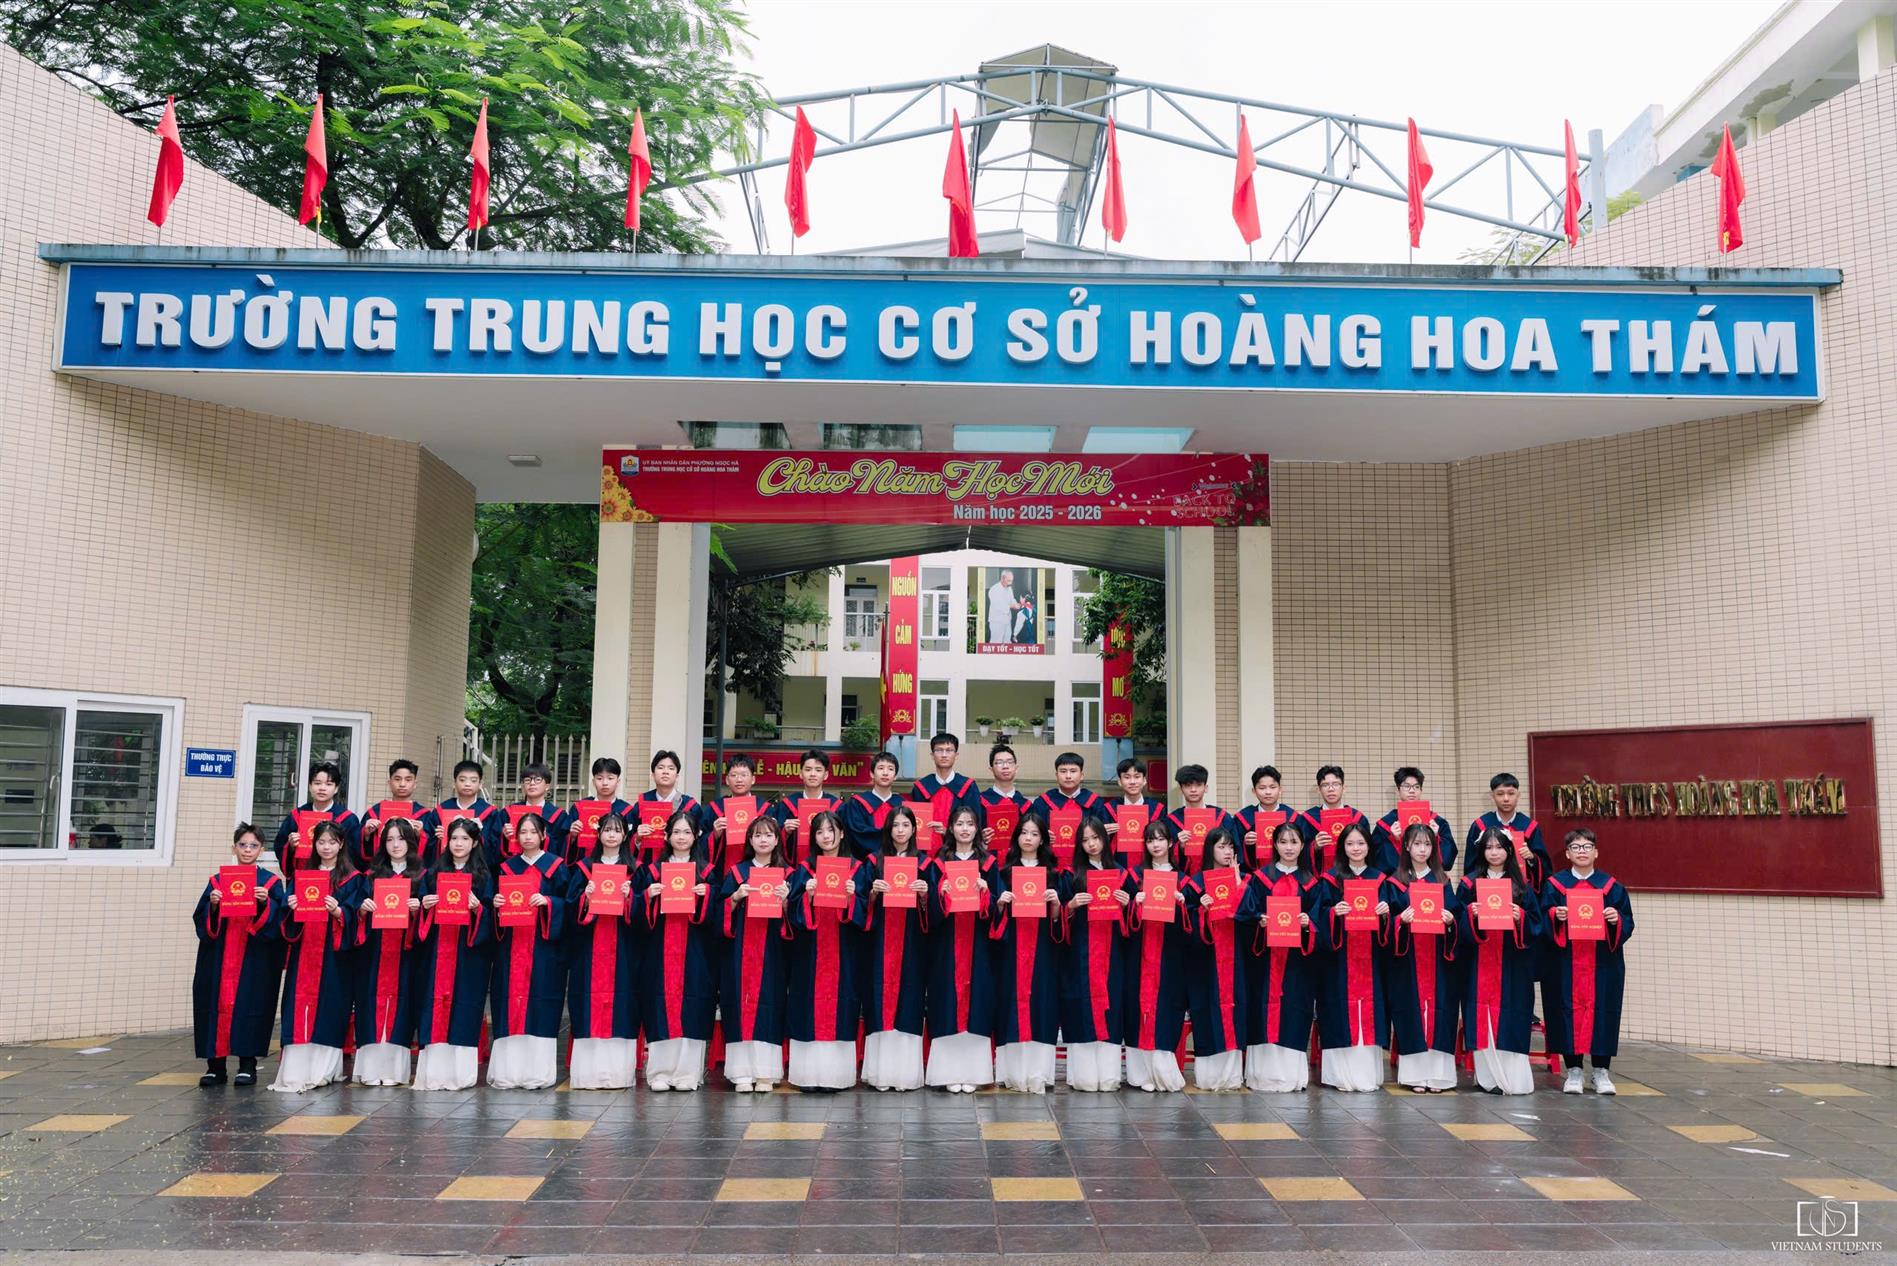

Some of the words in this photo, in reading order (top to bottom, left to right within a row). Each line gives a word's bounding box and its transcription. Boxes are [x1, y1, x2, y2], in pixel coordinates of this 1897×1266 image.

[95, 274, 398, 352] TRƯỜNG
[425, 298, 671, 356] TRUNG
[699, 302, 848, 373] HỌC
[878, 301, 977, 361] CƠ
[1005, 286, 1102, 365] SỞ
[1129, 293, 1382, 370] HOÀNG
[1410, 315, 1560, 373] HOA
[1580, 304, 1799, 376] THÁM
[757, 457, 855, 496] Chào
[851, 458, 946, 495] Năm
[943, 460, 1026, 501] Học
[1021, 460, 1115, 496] Mới
[953, 504, 985, 520] Năm
[990, 505, 1015, 523] học
[1019, 505, 1054, 520] 2025
[1067, 505, 1102, 520] 2026
[190, 752, 215, 762] THƯỜNG
[776, 761, 801, 778] HẬU
